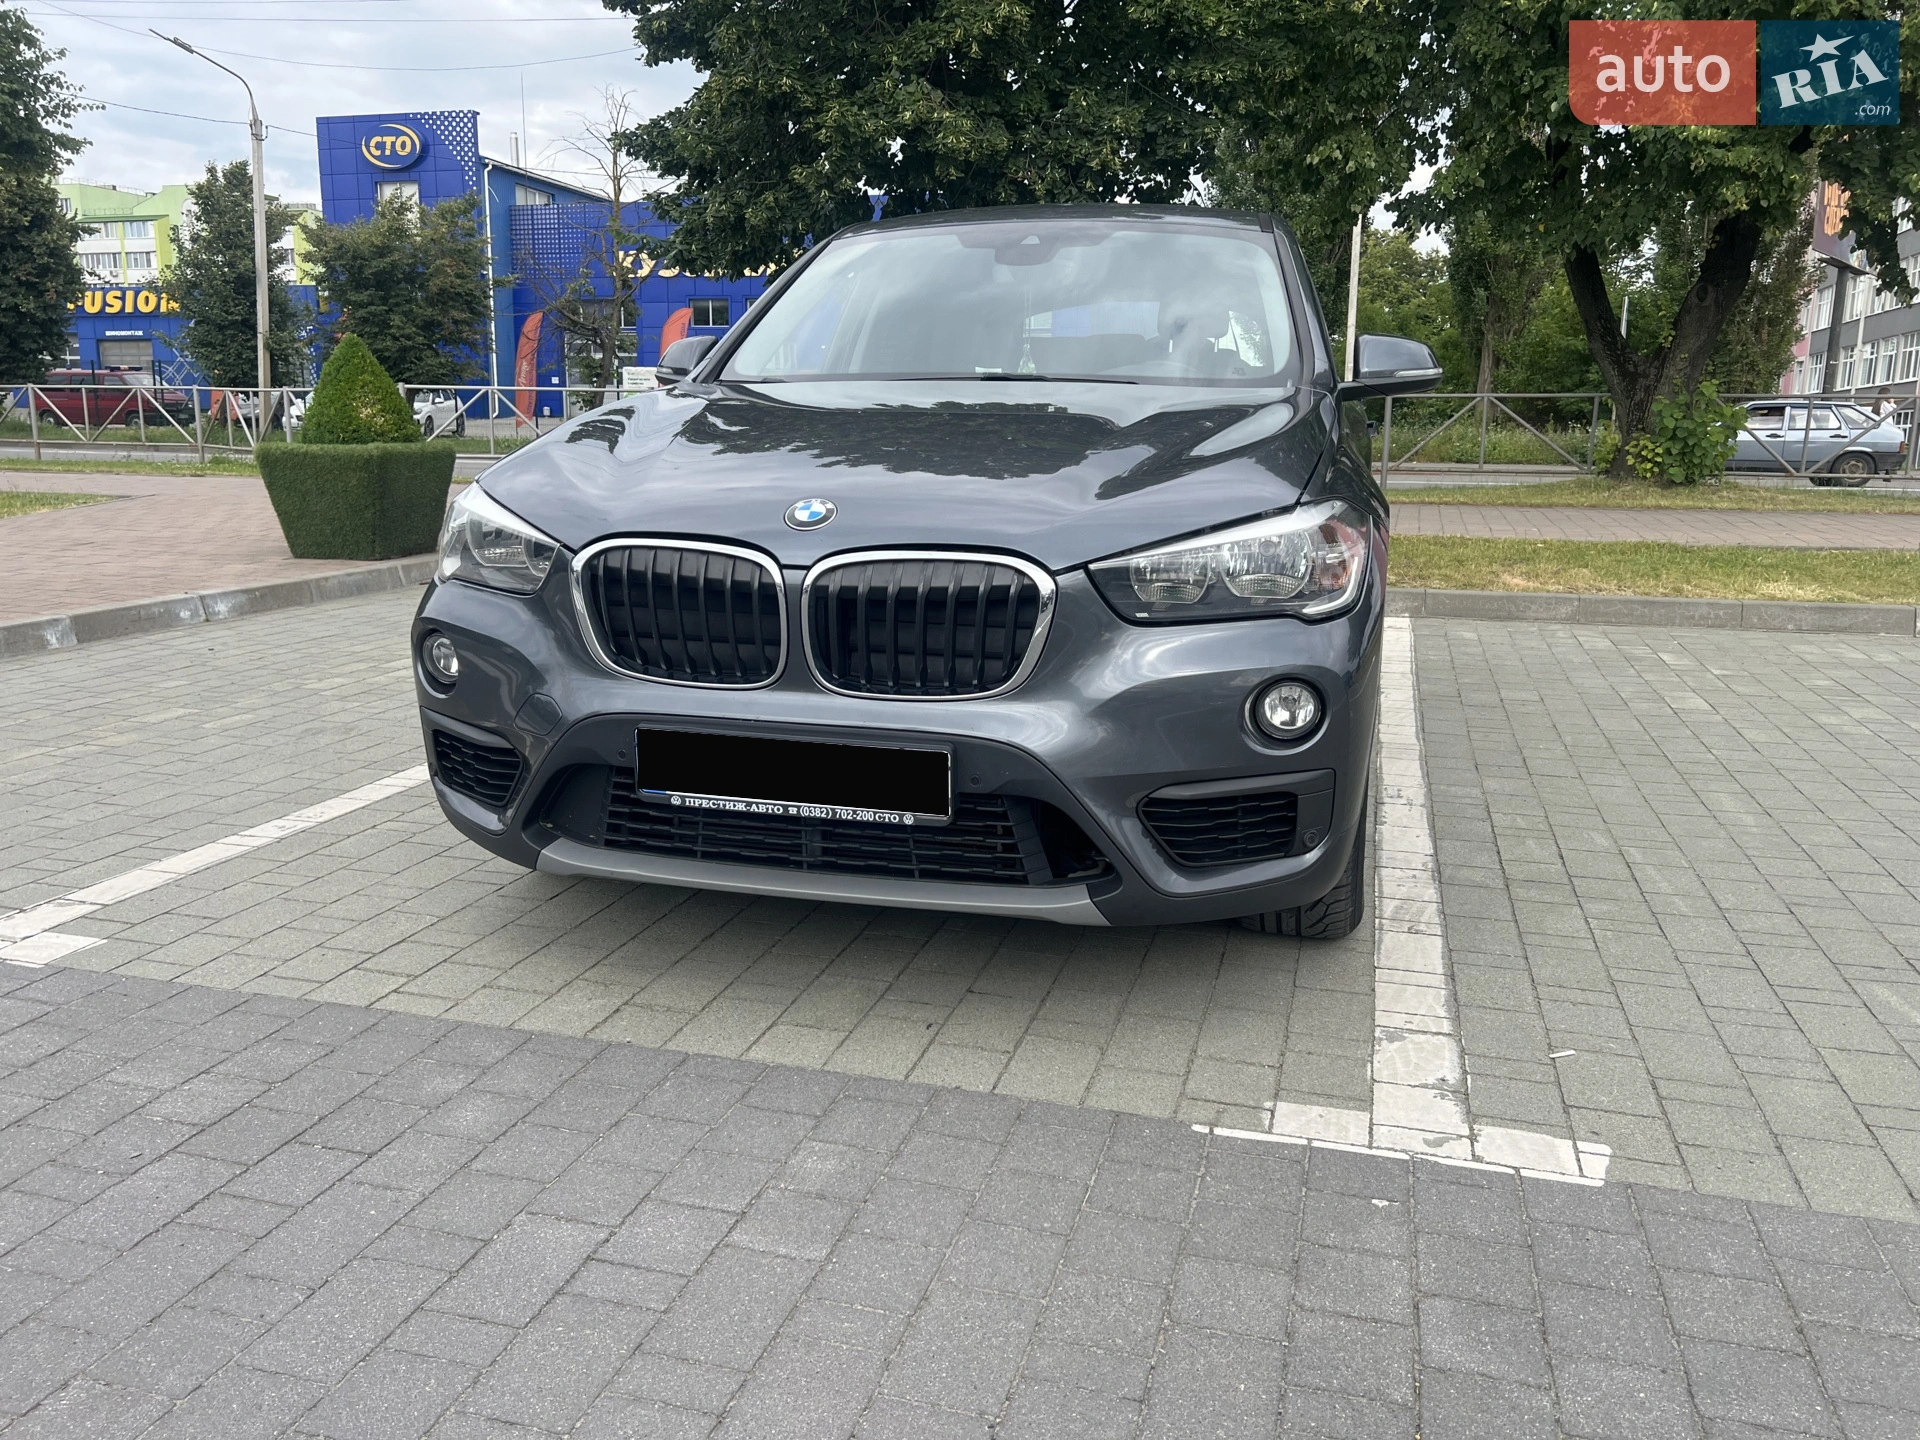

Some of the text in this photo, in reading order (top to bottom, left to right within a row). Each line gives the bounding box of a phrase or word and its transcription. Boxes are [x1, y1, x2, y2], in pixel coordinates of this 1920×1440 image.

[369, 135, 412, 156] СТО
[685, 798, 899, 822] ПРЕСТИЖ-АВТО (0382) 702-200 СТО
